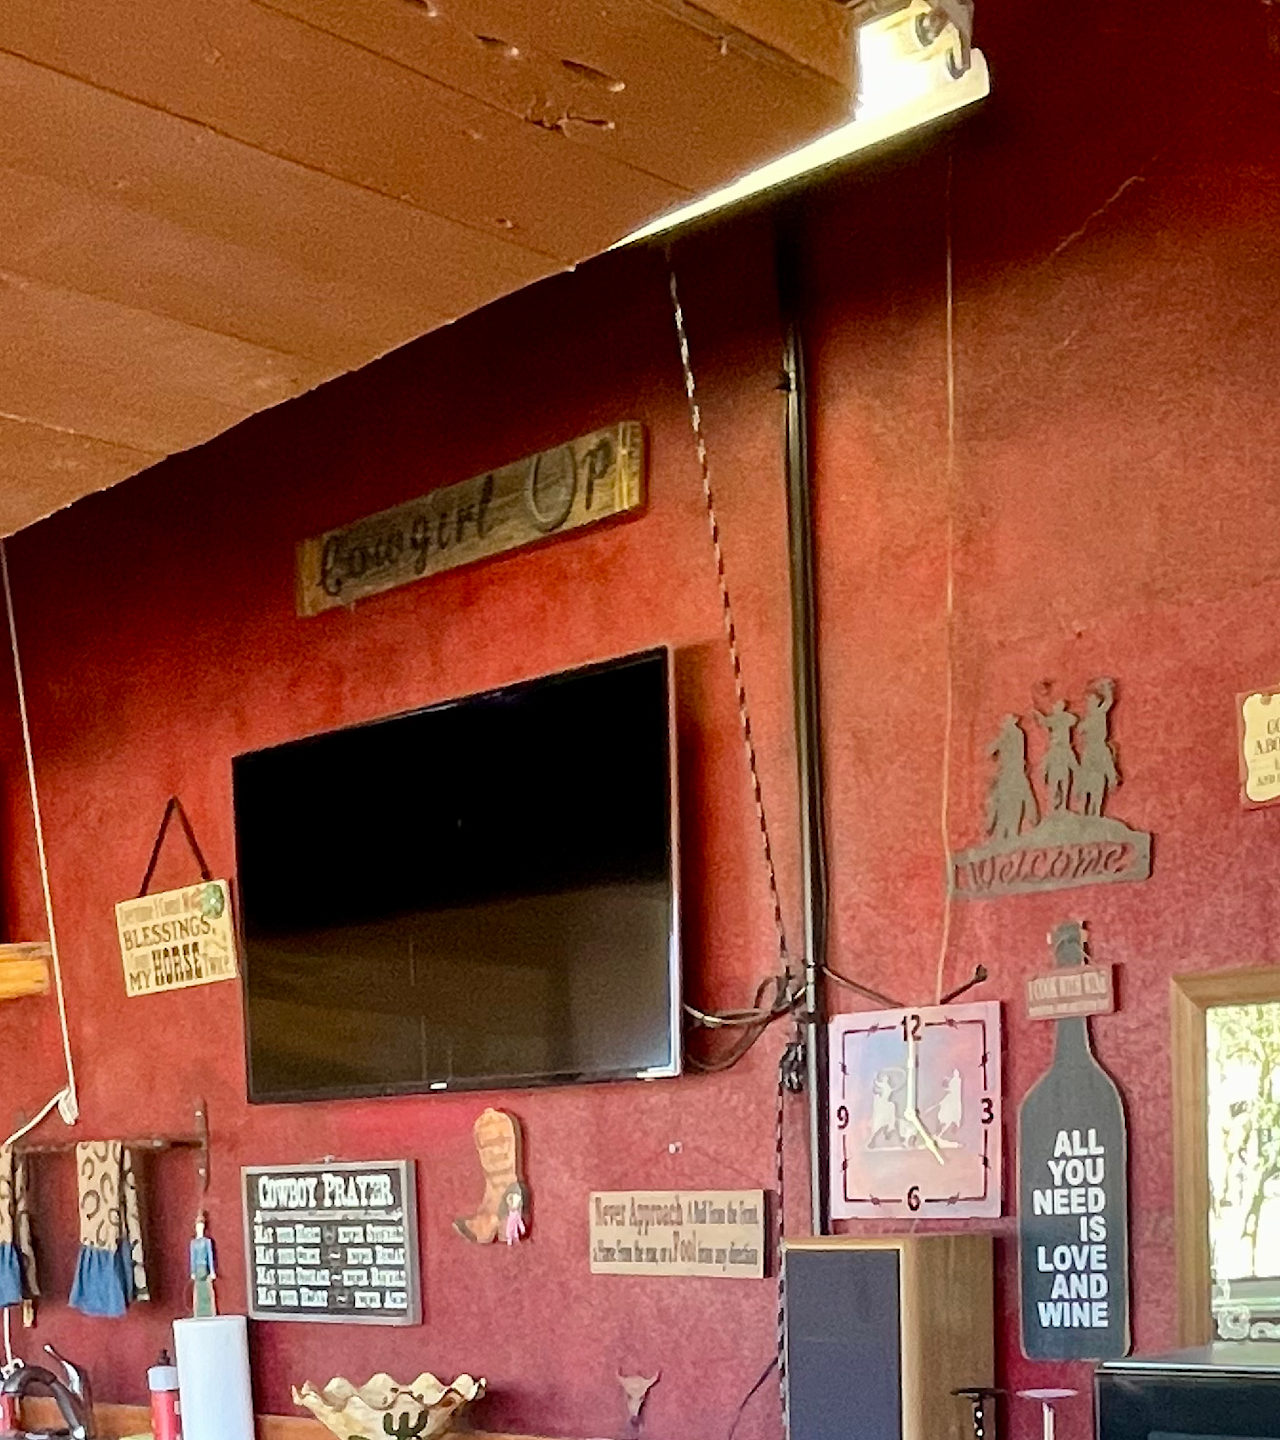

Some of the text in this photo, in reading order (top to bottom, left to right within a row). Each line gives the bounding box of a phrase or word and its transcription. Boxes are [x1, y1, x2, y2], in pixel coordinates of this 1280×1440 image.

[317, 474, 493, 596] Cowgirl
[969, 841, 1134, 891] Welcome
[152, 942, 203, 986] HORSE
[901, 1014, 921, 1041] 12
[836, 1105, 849, 1129] 9
[981, 1098, 994, 1124] 3
[1054, 1129, 1104, 1157] ALL
[1048, 1158, 1105, 1186] YOU
[258, 1173, 395, 1208] COWBOY PRAYER
[907, 1186, 920, 1211] 6
[1033, 1187, 1106, 1215] NEED
[595, 1197, 626, 1226] Never
[629, 1195, 683, 1236] Approach
[1080, 1215, 1106, 1242] IS
[672, 1230, 696, 1262] Fool
[1037, 1244, 1107, 1272] LOVE
[1051, 1272, 1108, 1299] AND
[1037, 1301, 1108, 1328] WINE
